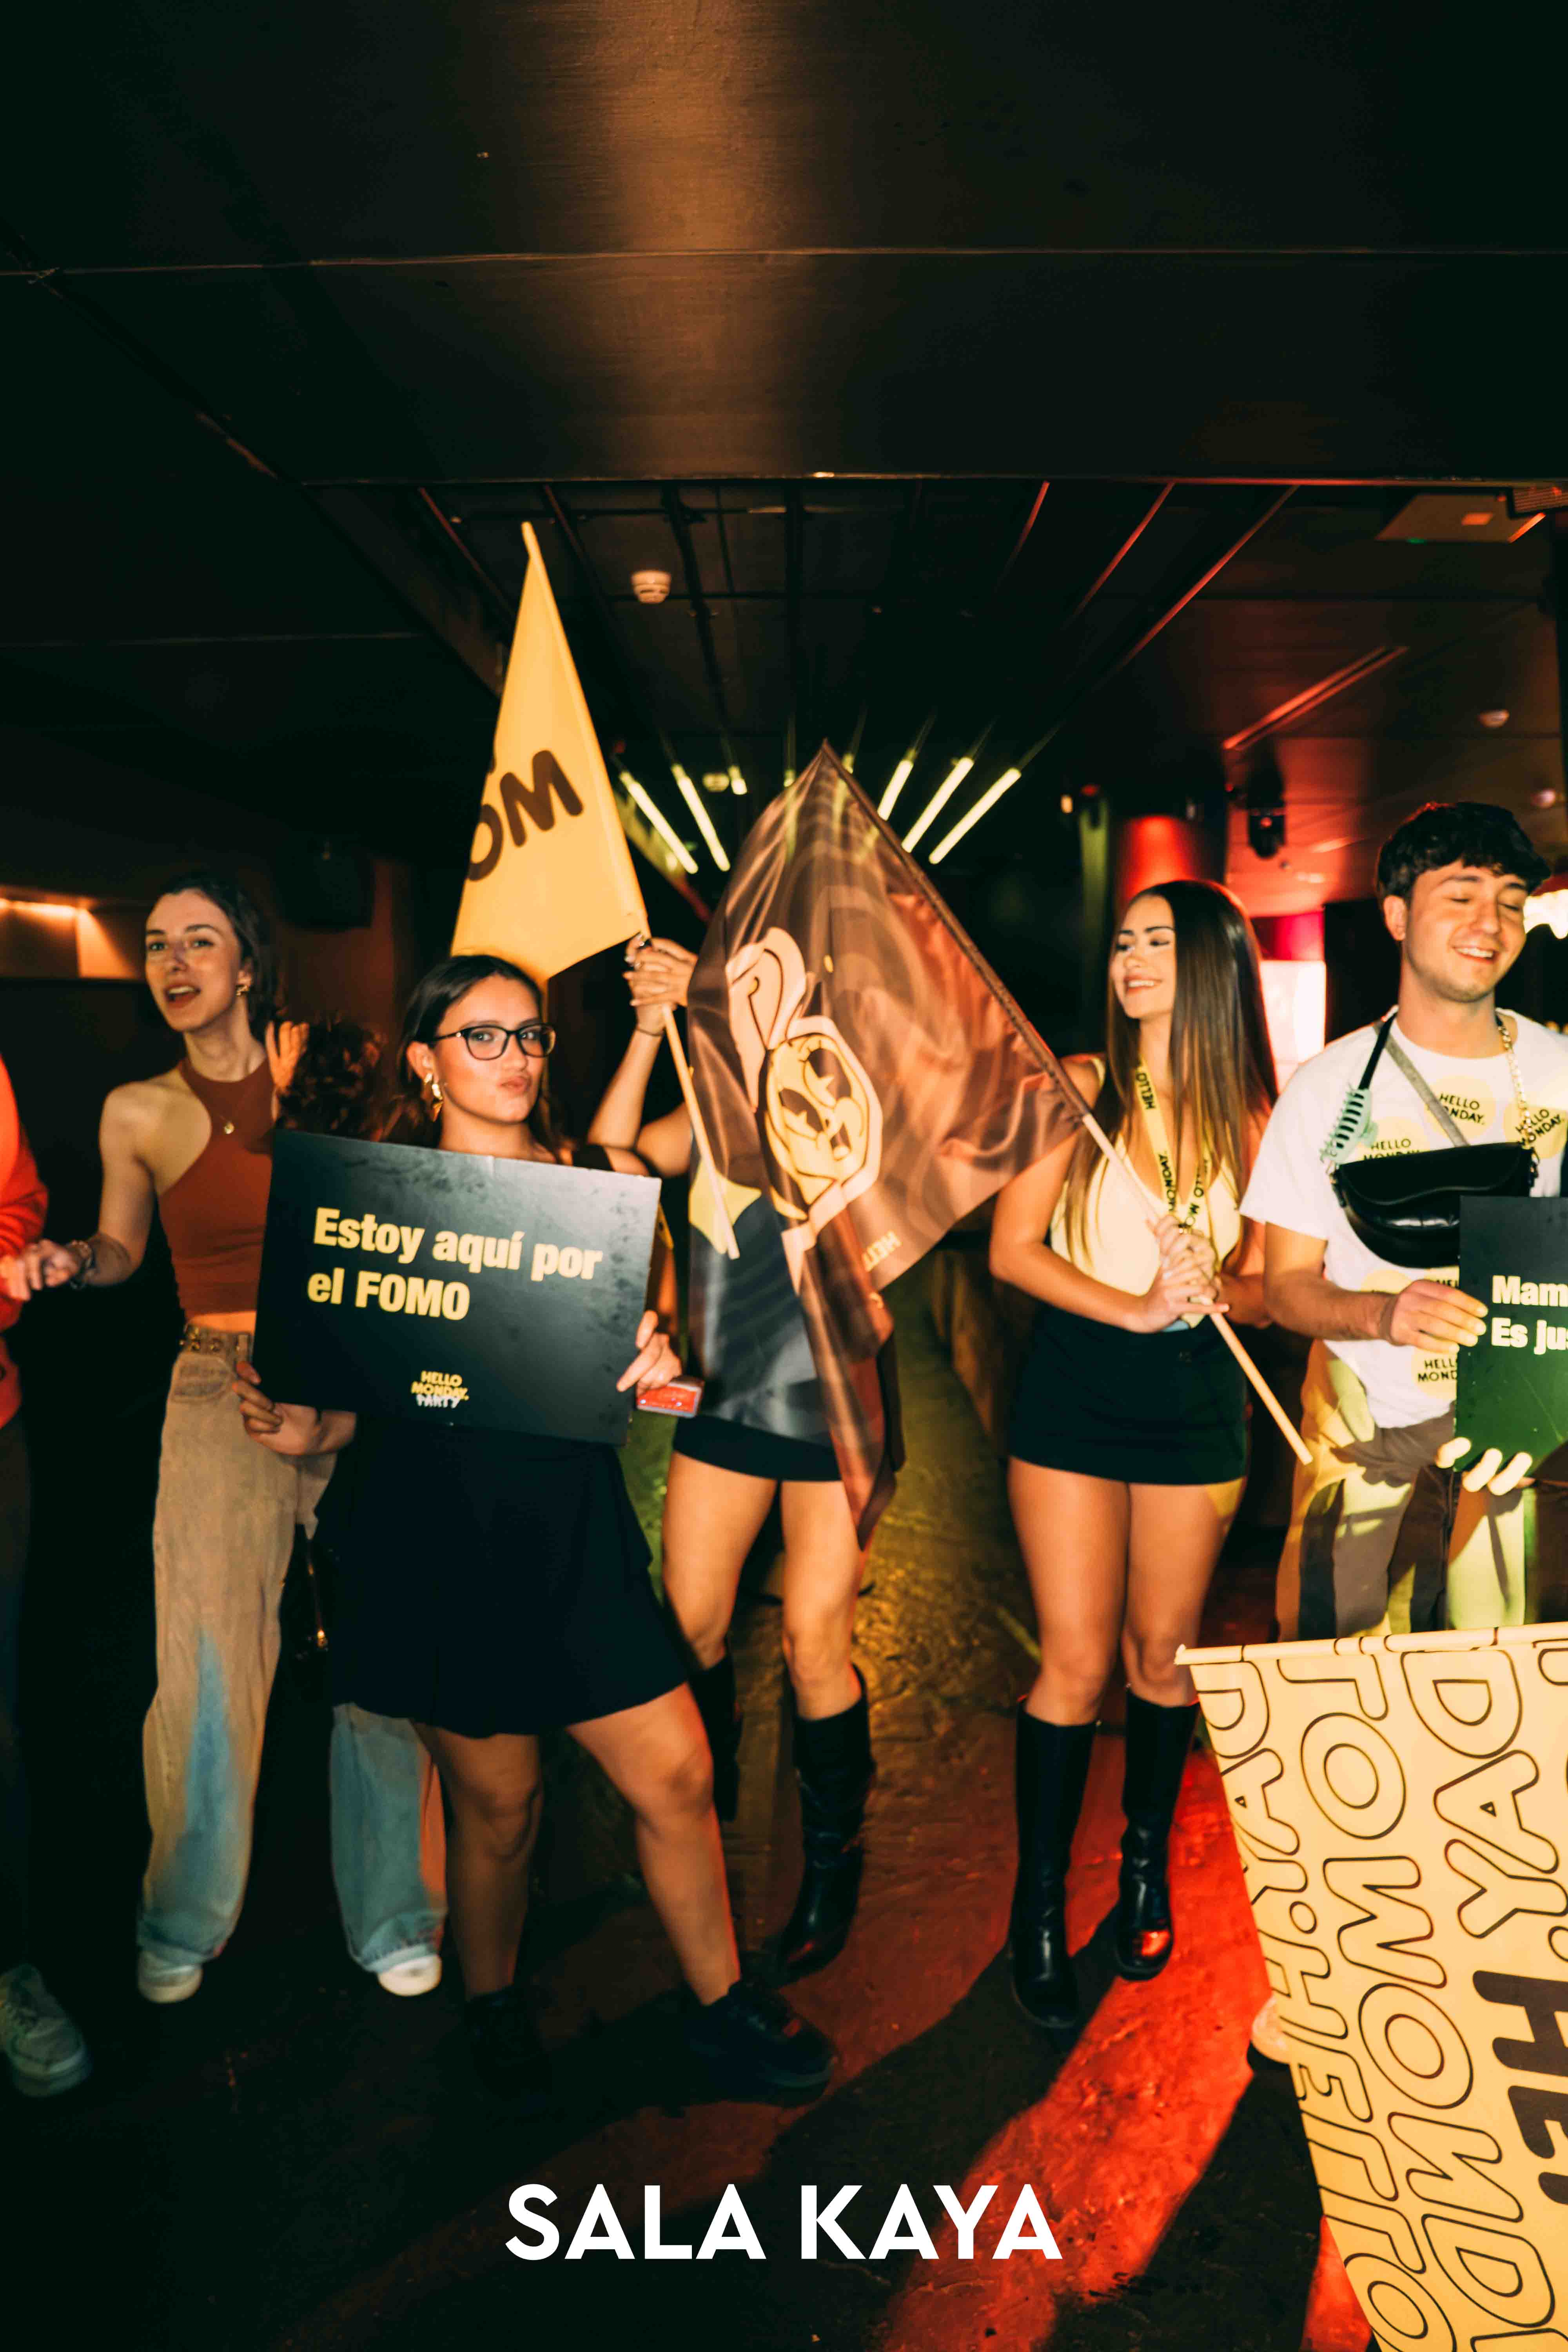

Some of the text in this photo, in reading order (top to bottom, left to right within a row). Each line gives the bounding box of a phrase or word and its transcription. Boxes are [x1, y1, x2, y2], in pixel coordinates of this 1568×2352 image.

[1136, 1072, 1156, 1109] HELLO
[1439, 1093, 1480, 1110] HELLO
[1443, 1106, 1486, 1125] NDAY.
[1371, 1138, 1411, 1150] HELLO
[315, 1207, 604, 1281] Estoy aquí por
[308, 1267, 471, 1320] el FOMO
[1492, 1275, 1568, 1307] Mam
[1492, 1317, 1528, 1348] Es
[1425, 1357, 1457, 1370] HELL
[421, 1370, 463, 1387] HELLO
[411, 1381, 470, 1401] MONDAY.
[416, 1393, 462, 1409] PARTY
